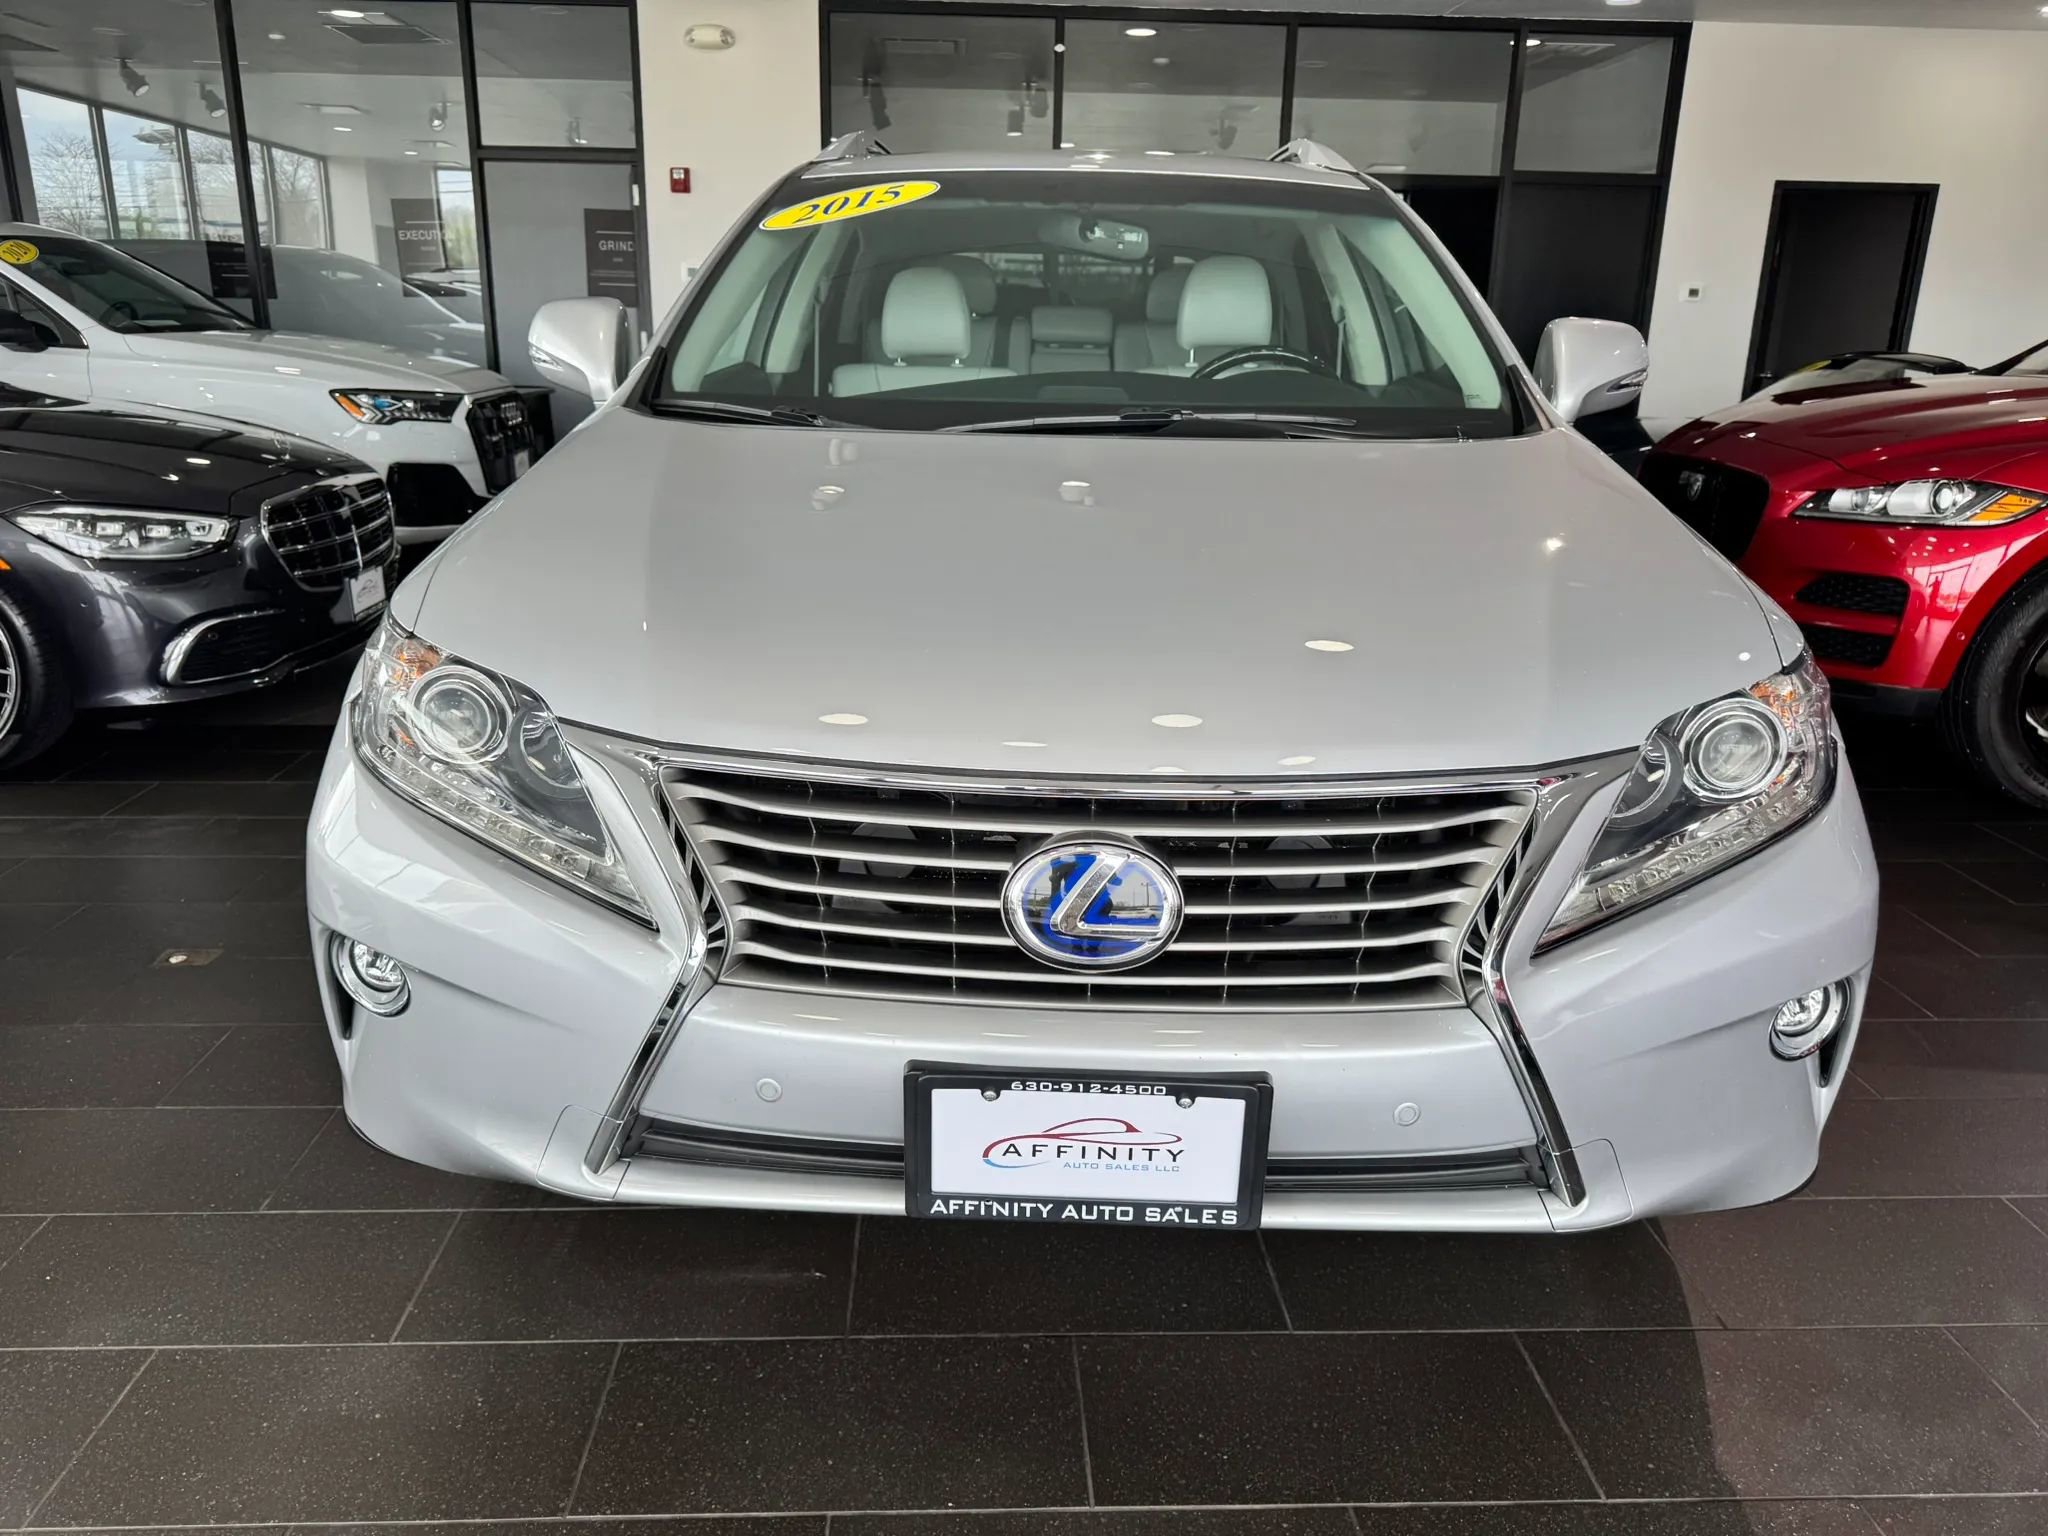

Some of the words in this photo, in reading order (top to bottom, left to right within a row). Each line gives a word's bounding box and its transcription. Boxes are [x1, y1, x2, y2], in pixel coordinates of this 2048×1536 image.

[792, 184, 905, 224] 2015
[1011, 1081, 1167, 1095] 630-912-4500
[1002, 1143, 1185, 1163] AFFINITY
[1063, 1161, 1099, 1170] AUTO
[1105, 1163, 1149, 1172] SALES
[1155, 1165, 1180, 1173] LLC
[930, 1199, 1054, 1218] AFFINITY
[1061, 1203, 1134, 1222] AUTO
[1145, 1206, 1238, 1225] SALES
